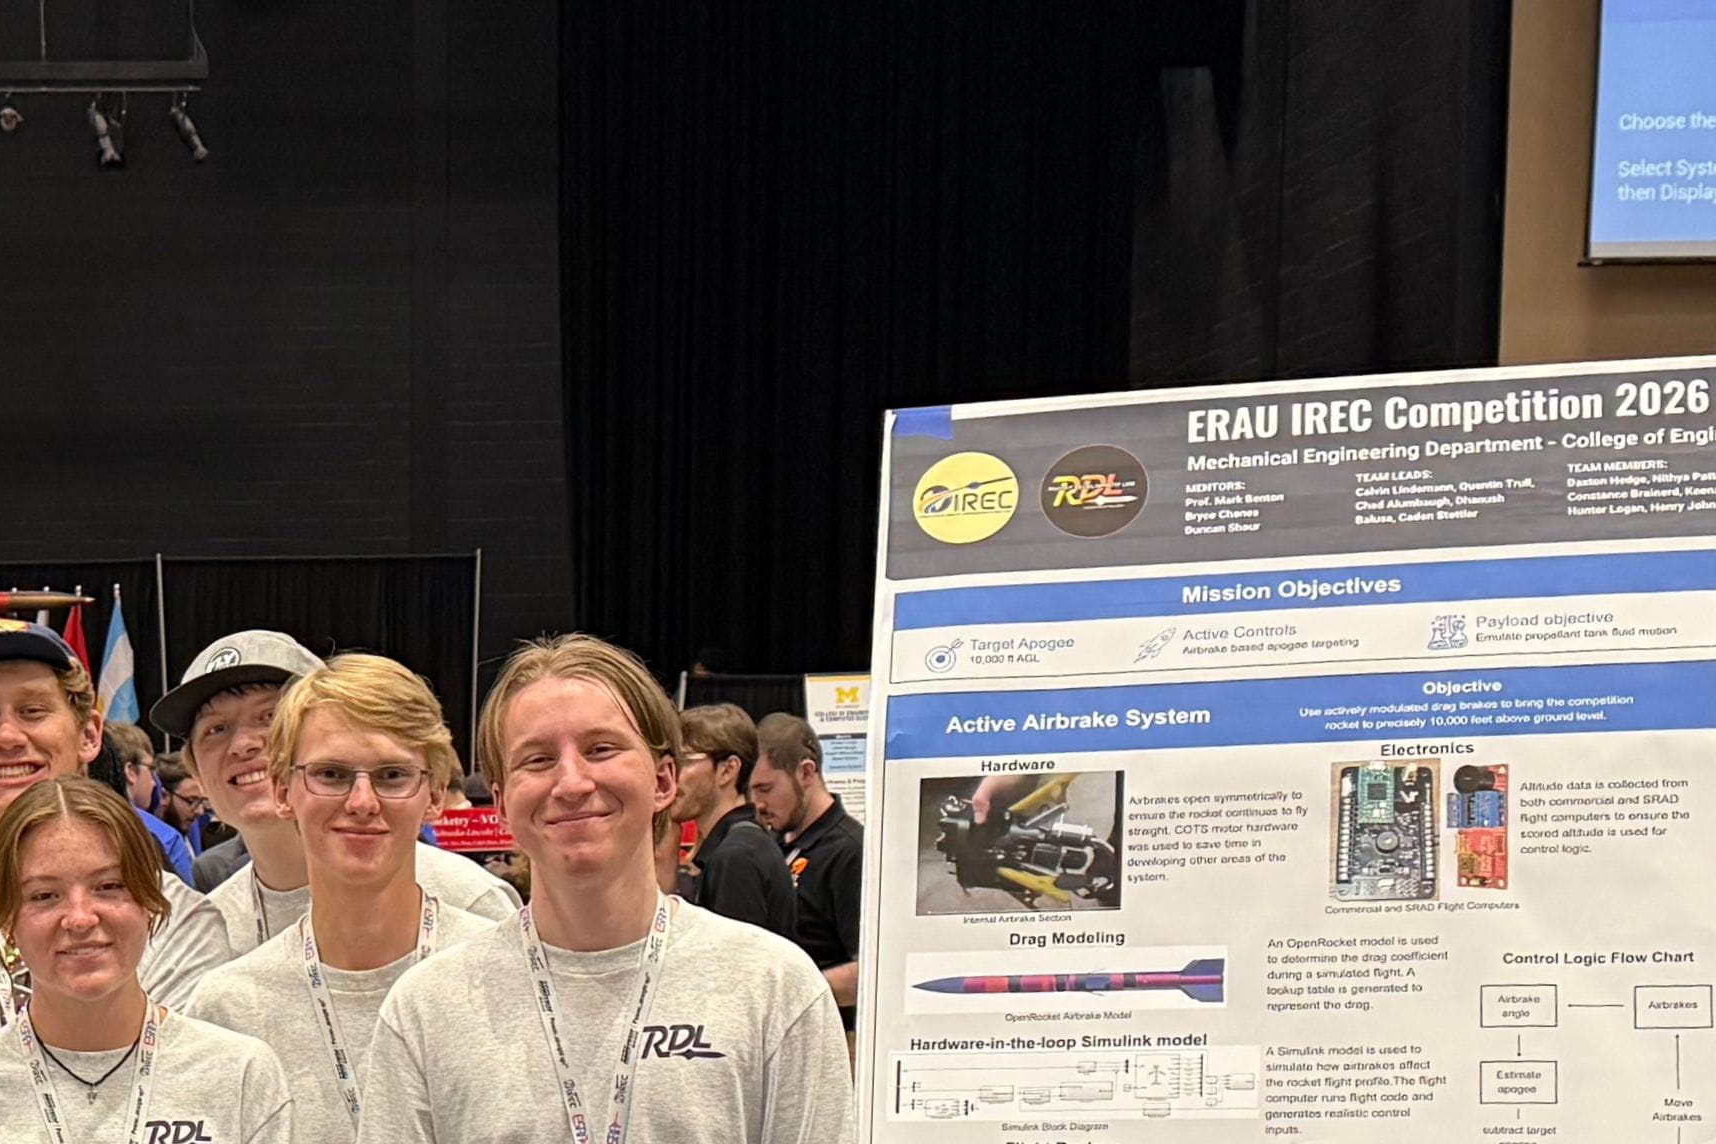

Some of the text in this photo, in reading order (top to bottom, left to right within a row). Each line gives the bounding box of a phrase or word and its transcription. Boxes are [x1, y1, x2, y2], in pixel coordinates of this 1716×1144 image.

[1619, 111, 1716, 130] Choose the
[1618, 159, 1672, 177] Select
[1618, 184, 1655, 201] then
[1187, 379, 1709, 443] ERAU IREC Competition 2026
[1187, 449, 1298, 471] Mechanical
[1303, 443, 1419, 465] Engineering
[1425, 437, 1543, 458] Department
[1561, 431, 1638, 450] College
[1643, 428, 1665, 445] of
[1355, 470, 1433, 482] TEAM LEADS:
[1566, 463, 1601, 473] TEAM
[1053, 474, 1123, 507] RDL
[954, 490, 1013, 511] IREC
[1182, 577, 1401, 603] Mission Objectives
[1476, 612, 1613, 629] Payload objective
[1182, 624, 1296, 640] Active Controls
[970, 637, 1075, 652] Target Apogee
[1182, 638, 1359, 654] Airbrake based apogee targeting
[970, 654, 1004, 664] 10,000
[1016, 653, 1040, 662] AGL
[1422, 680, 1502, 696] Objective
[945, 709, 1210, 733] Active Airbrake System
[1380, 741, 1474, 756] Electronics
[981, 759, 1055, 772] Hardware
[1009, 931, 1125, 947] Drag Modeling
[1502, 951, 1694, 967] Control Logic Flow Chart
[1497, 994, 1540, 1003] Airbrake
[1648, 1000, 1698, 1009] Airbrakes
[1501, 1009, 1530, 1019] angle
[642, 1024, 718, 1058] RDL
[910, 1033, 1207, 1051] Hardware-in-the-loop Simulink model
[1496, 1070, 1541, 1079] Estimate
[1497, 1086, 1537, 1095] apogee
[1664, 1098, 1693, 1107] Move
[1652, 1112, 1702, 1121] Airbrakes
[1482, 1126, 1556, 1136] subtract target
